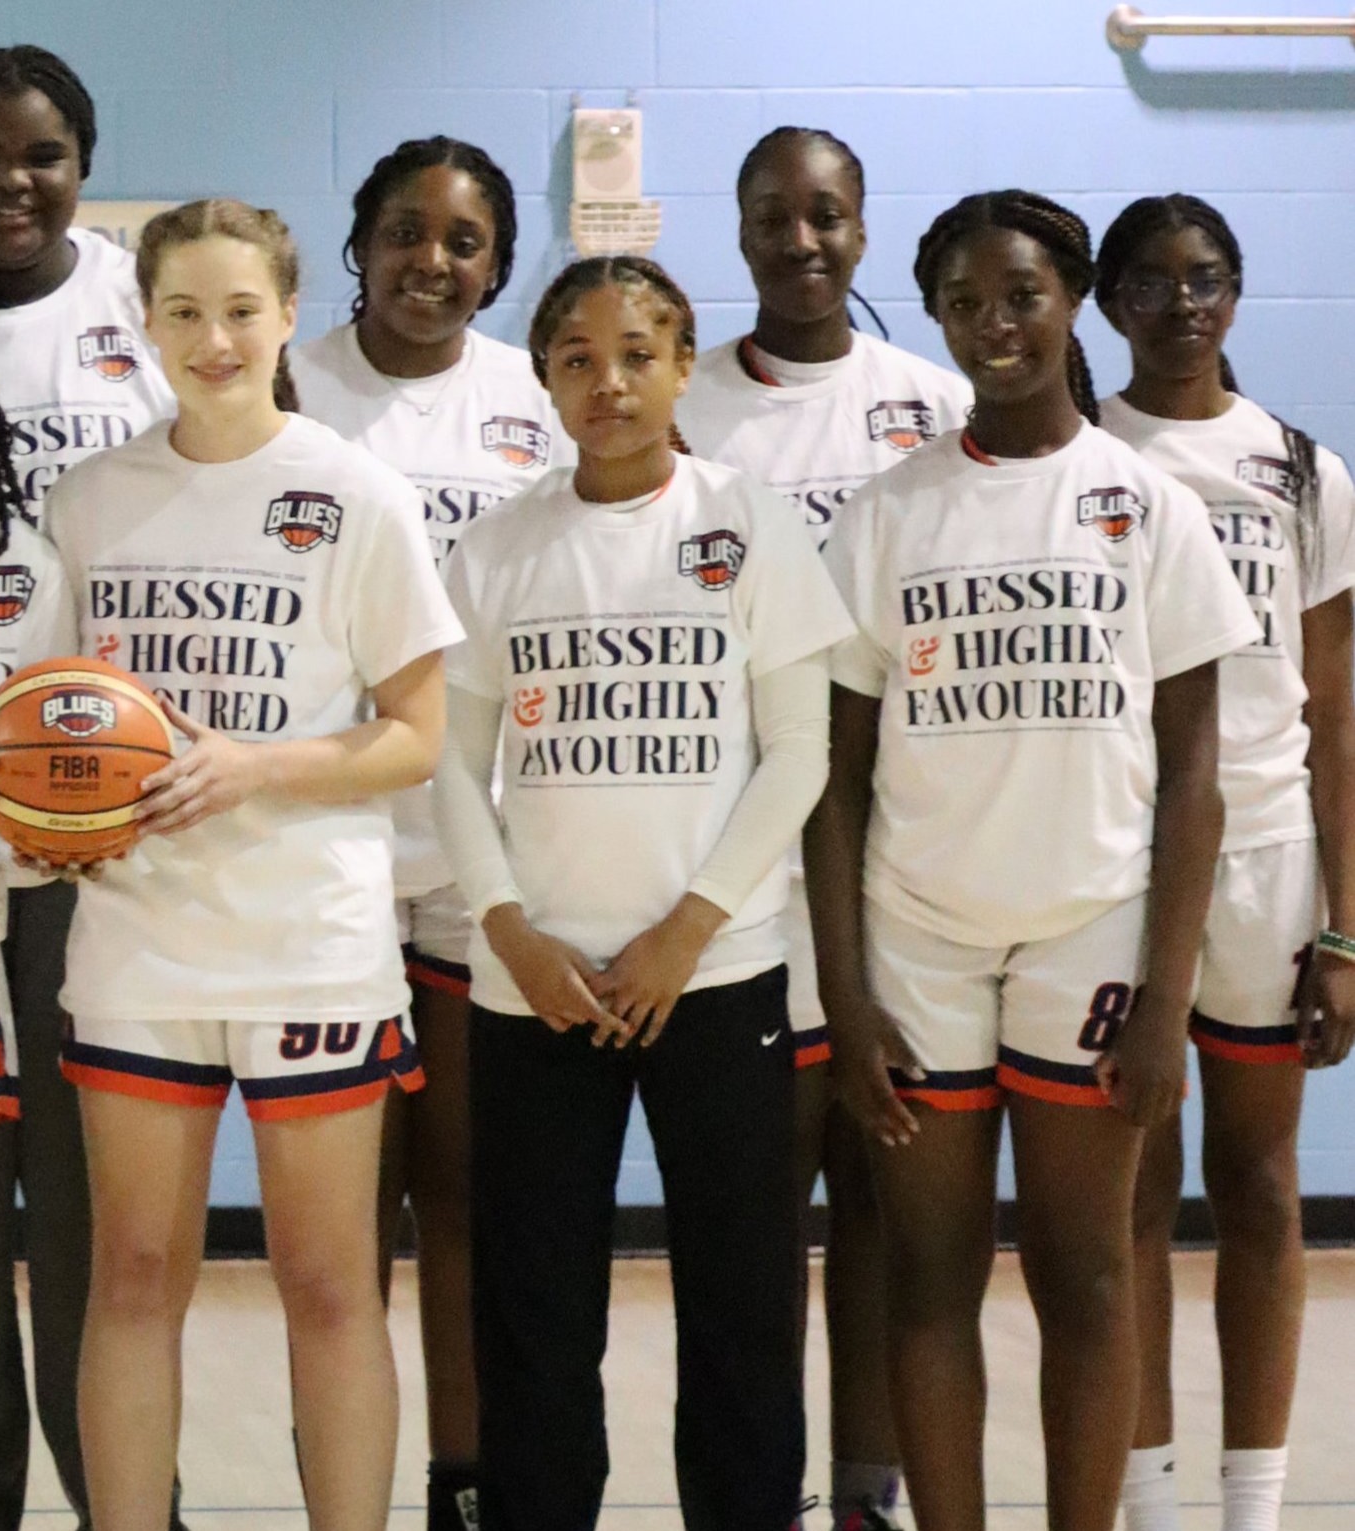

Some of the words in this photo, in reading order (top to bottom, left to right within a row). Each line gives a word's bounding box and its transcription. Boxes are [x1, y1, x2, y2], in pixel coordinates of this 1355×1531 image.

[483, 421, 549, 461] BLUES
[868, 408, 937, 435] BLUES
[267, 499, 341, 537] BLUES
[90, 580, 302, 627] BLESSED
[901, 570, 1127, 626] BLESSED
[129, 634, 296, 679] HIGHLY
[510, 626, 727, 675] BLESSED
[953, 625, 1123, 670] HIGHLY
[43, 696, 116, 728] BLUES
[557, 681, 725, 723] HIGHLY
[905, 679, 1125, 726] FAVOURED
[50, 755, 99, 778] FIBA
